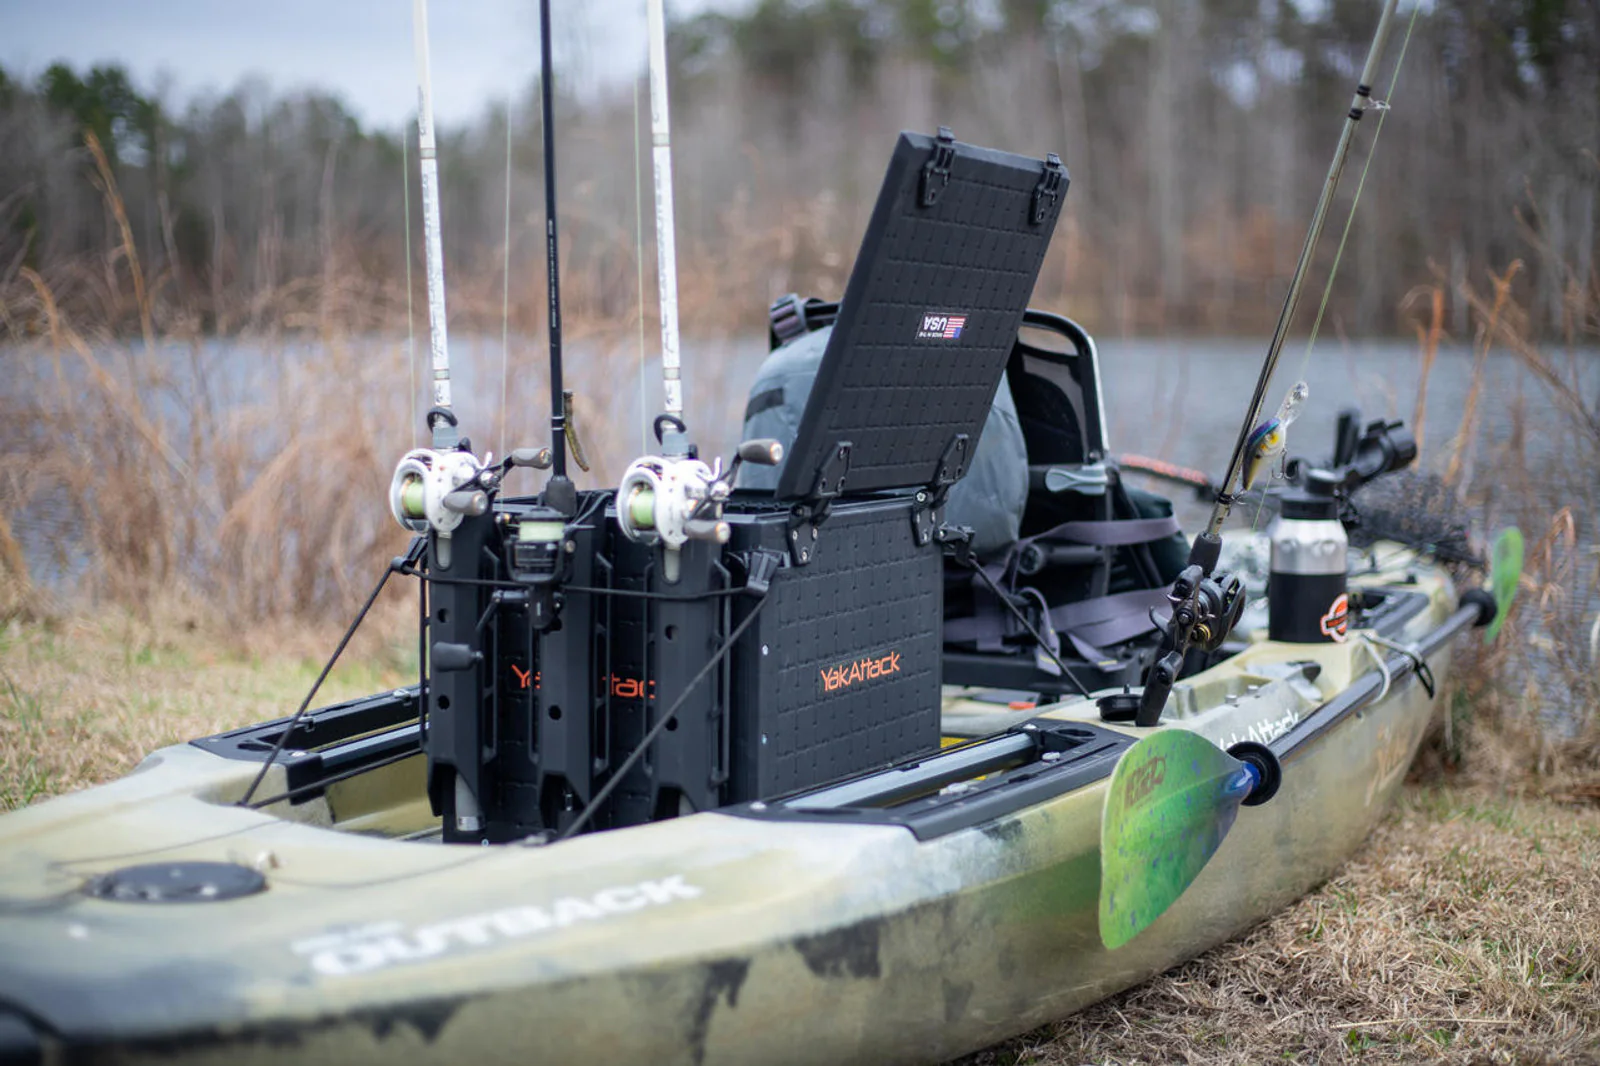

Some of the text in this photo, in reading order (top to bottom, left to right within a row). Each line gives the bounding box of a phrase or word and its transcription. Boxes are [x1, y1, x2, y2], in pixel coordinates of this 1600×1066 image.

[923, 315, 948, 331] USA
[820, 651, 900, 691] YakAttack
[312, 875, 702, 975] OUTBACK
